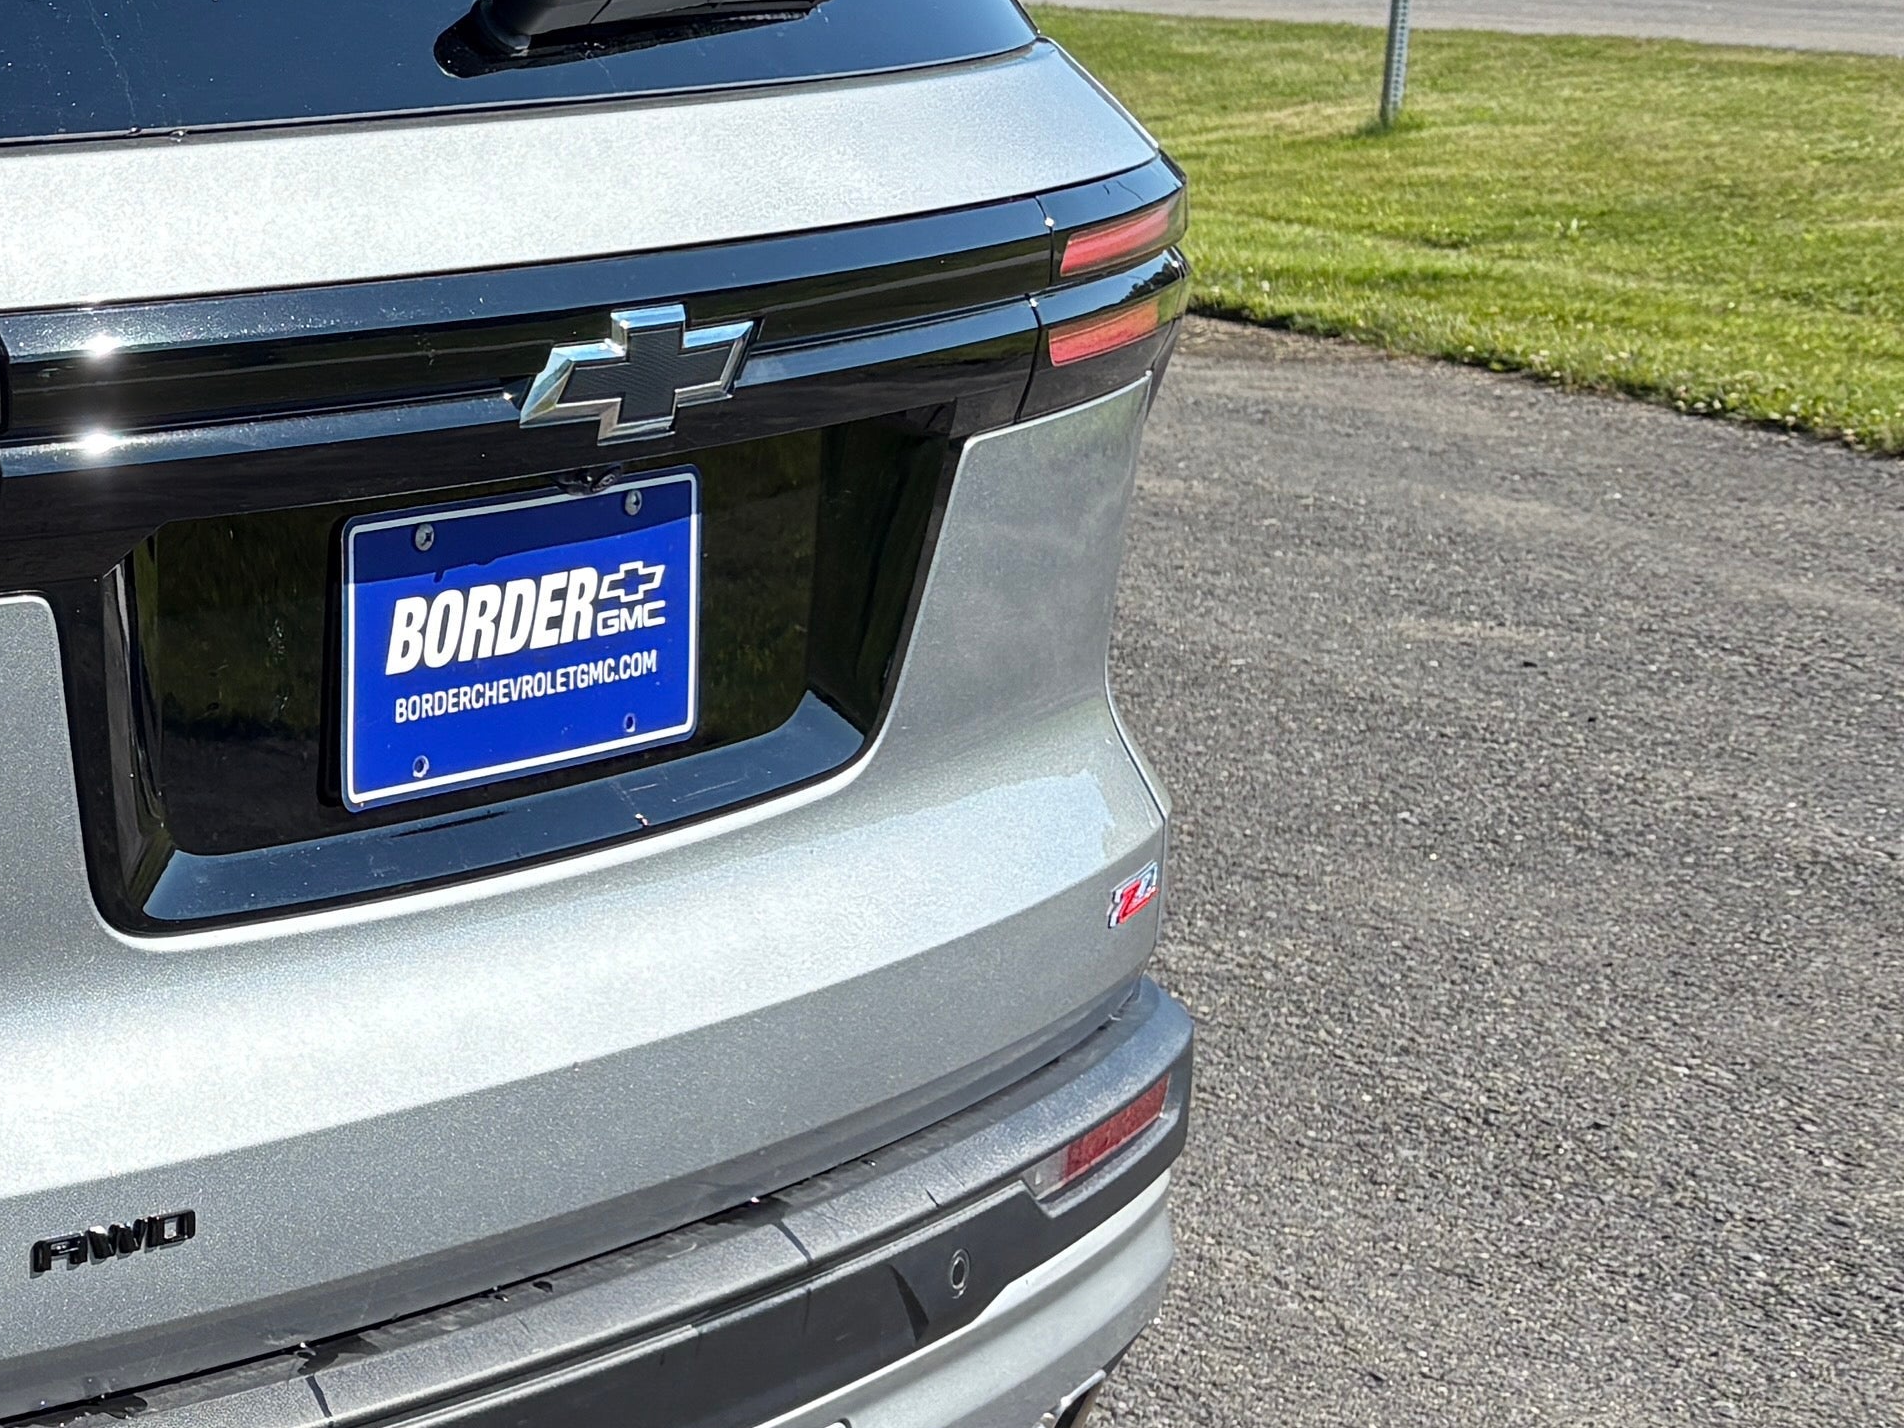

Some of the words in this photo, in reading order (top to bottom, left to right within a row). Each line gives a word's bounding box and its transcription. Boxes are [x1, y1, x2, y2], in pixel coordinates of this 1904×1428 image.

[385, 566, 598, 676] BORDER
[597, 600, 666, 637] GMC
[394, 649, 658, 724] BORDERCHEVROLETGMC.COM
[30, 1208, 197, 1277] AWD
